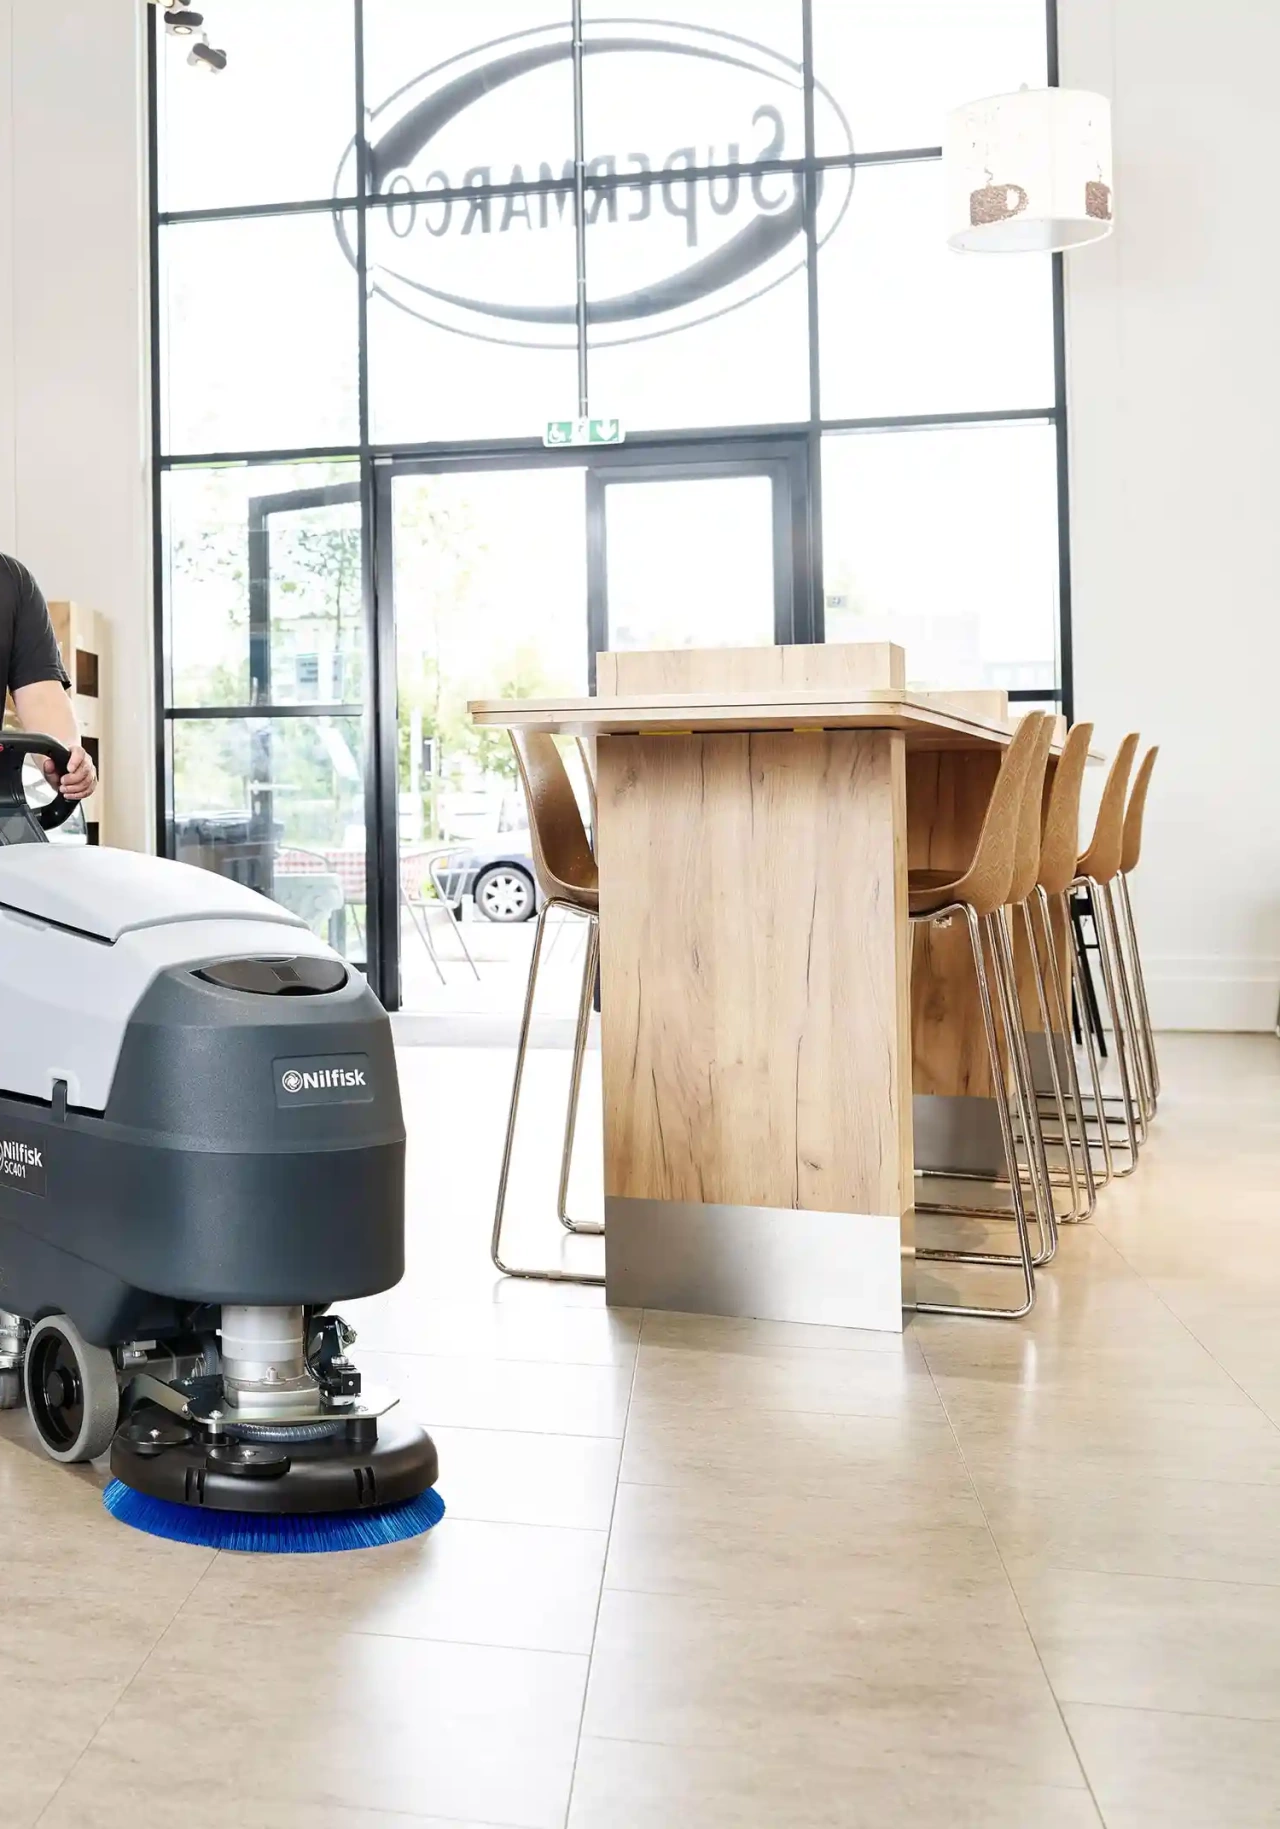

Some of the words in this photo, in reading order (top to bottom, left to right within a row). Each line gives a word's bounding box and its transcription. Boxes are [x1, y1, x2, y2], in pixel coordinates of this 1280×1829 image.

[303, 1069, 366, 1089] Nilfisk
[3, 1140, 43, 1168] Nilfisk
[4, 1160, 26, 1178] SC401
